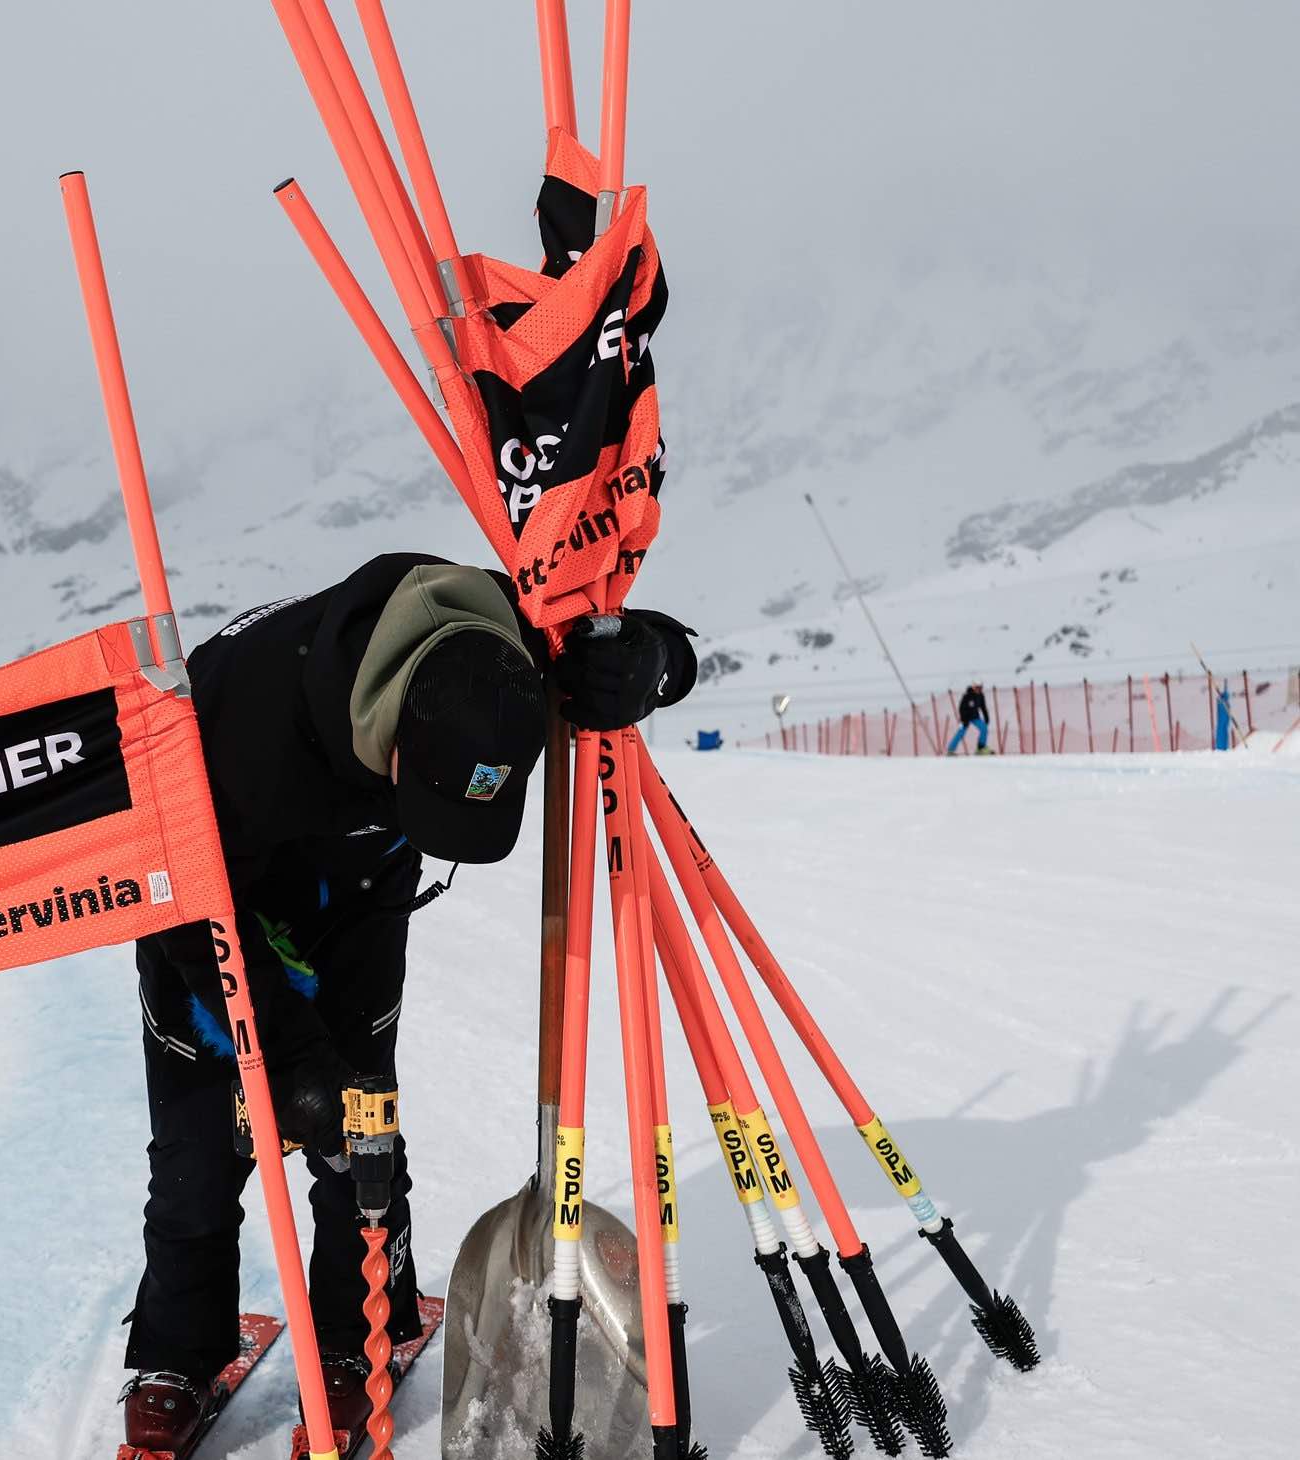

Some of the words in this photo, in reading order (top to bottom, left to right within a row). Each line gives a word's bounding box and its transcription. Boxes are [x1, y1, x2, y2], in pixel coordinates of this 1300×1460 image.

[723, 1129, 757, 1191] SPM
[756, 1133, 792, 1194] SPM
[875, 1137, 914, 1186] SPM
[560, 1157, 581, 1225] SPM
